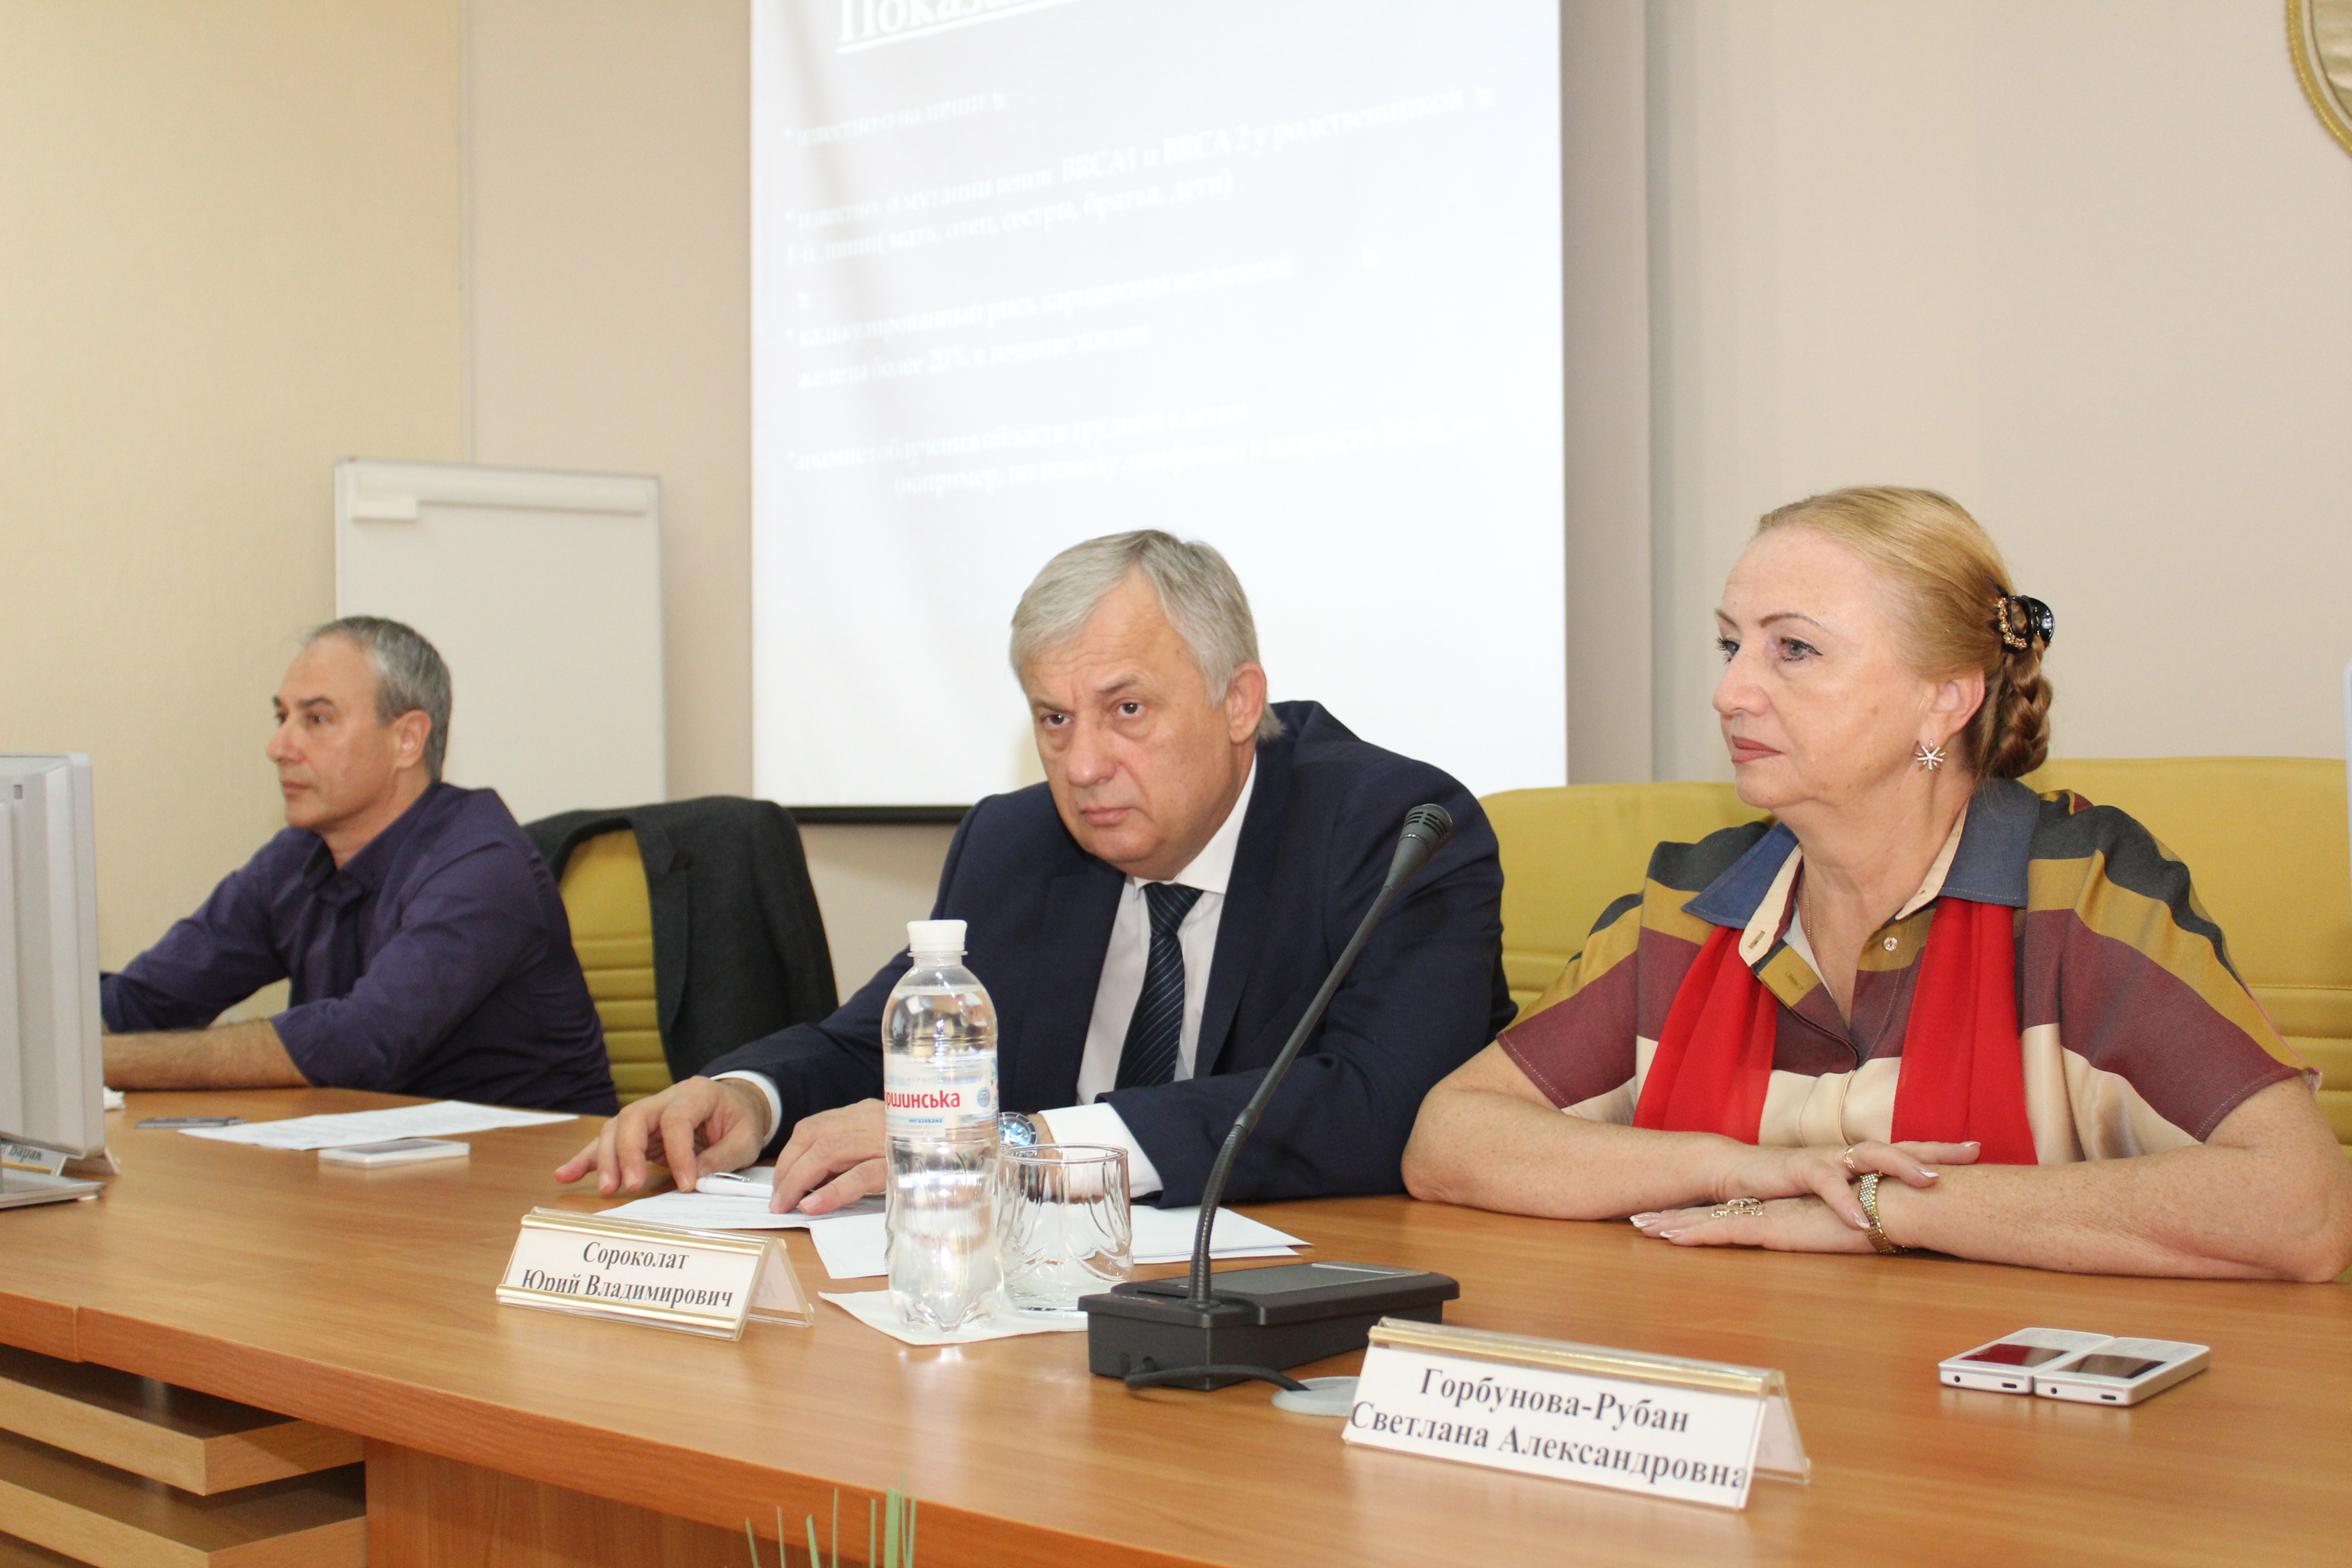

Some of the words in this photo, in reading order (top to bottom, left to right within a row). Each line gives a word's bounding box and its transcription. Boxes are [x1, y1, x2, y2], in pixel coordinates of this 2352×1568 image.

[1163, 128, 1232, 164] BRCA
[1234, 124, 1250, 152] 2
[884, 1090, 960, 1110] ршинська
[583, 1241, 690, 1270] Сороколат
[520, 1269, 581, 1294] Юрий
[584, 1274, 734, 1308] Владимирович
[1418, 1367, 1691, 1433] Горбунова-Рубан
[1349, 1401, 1489, 1449] Светлана
[1497, 1425, 1748, 1490] Александровна
